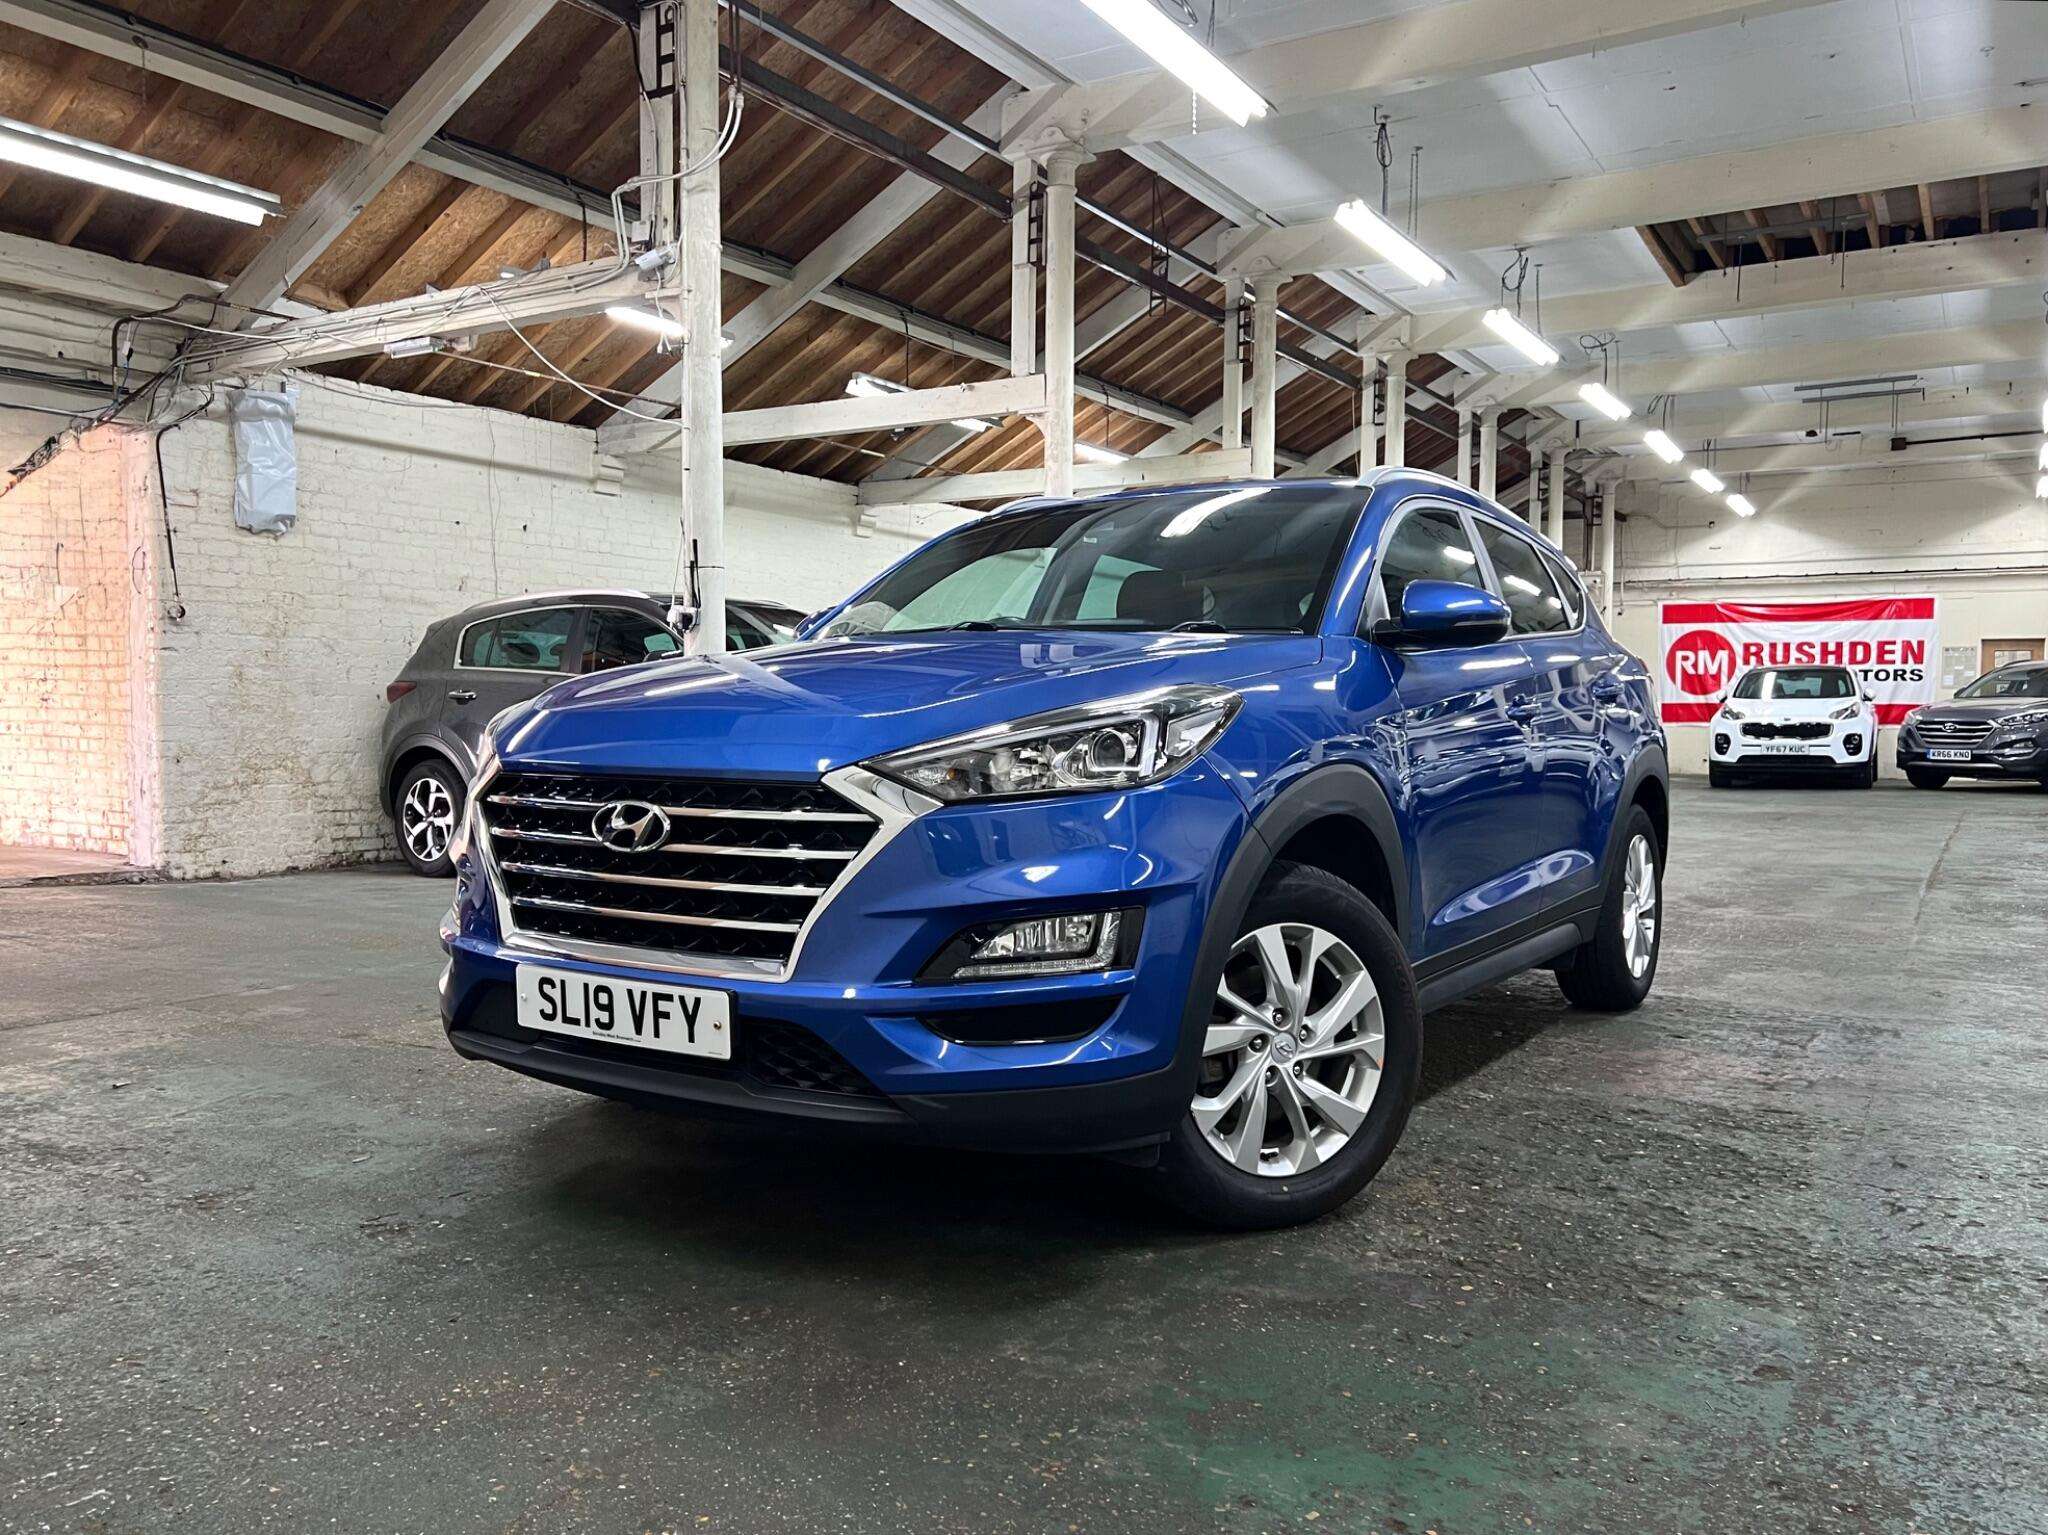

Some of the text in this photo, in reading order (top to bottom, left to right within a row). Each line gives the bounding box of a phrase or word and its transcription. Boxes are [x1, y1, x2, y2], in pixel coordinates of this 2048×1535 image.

[1675, 649, 1729, 690] RM
[1742, 640, 1925, 666] RUSHDEN
[1856, 669, 1923, 682] TORS
[538, 976, 702, 1043] SL19 VFY
